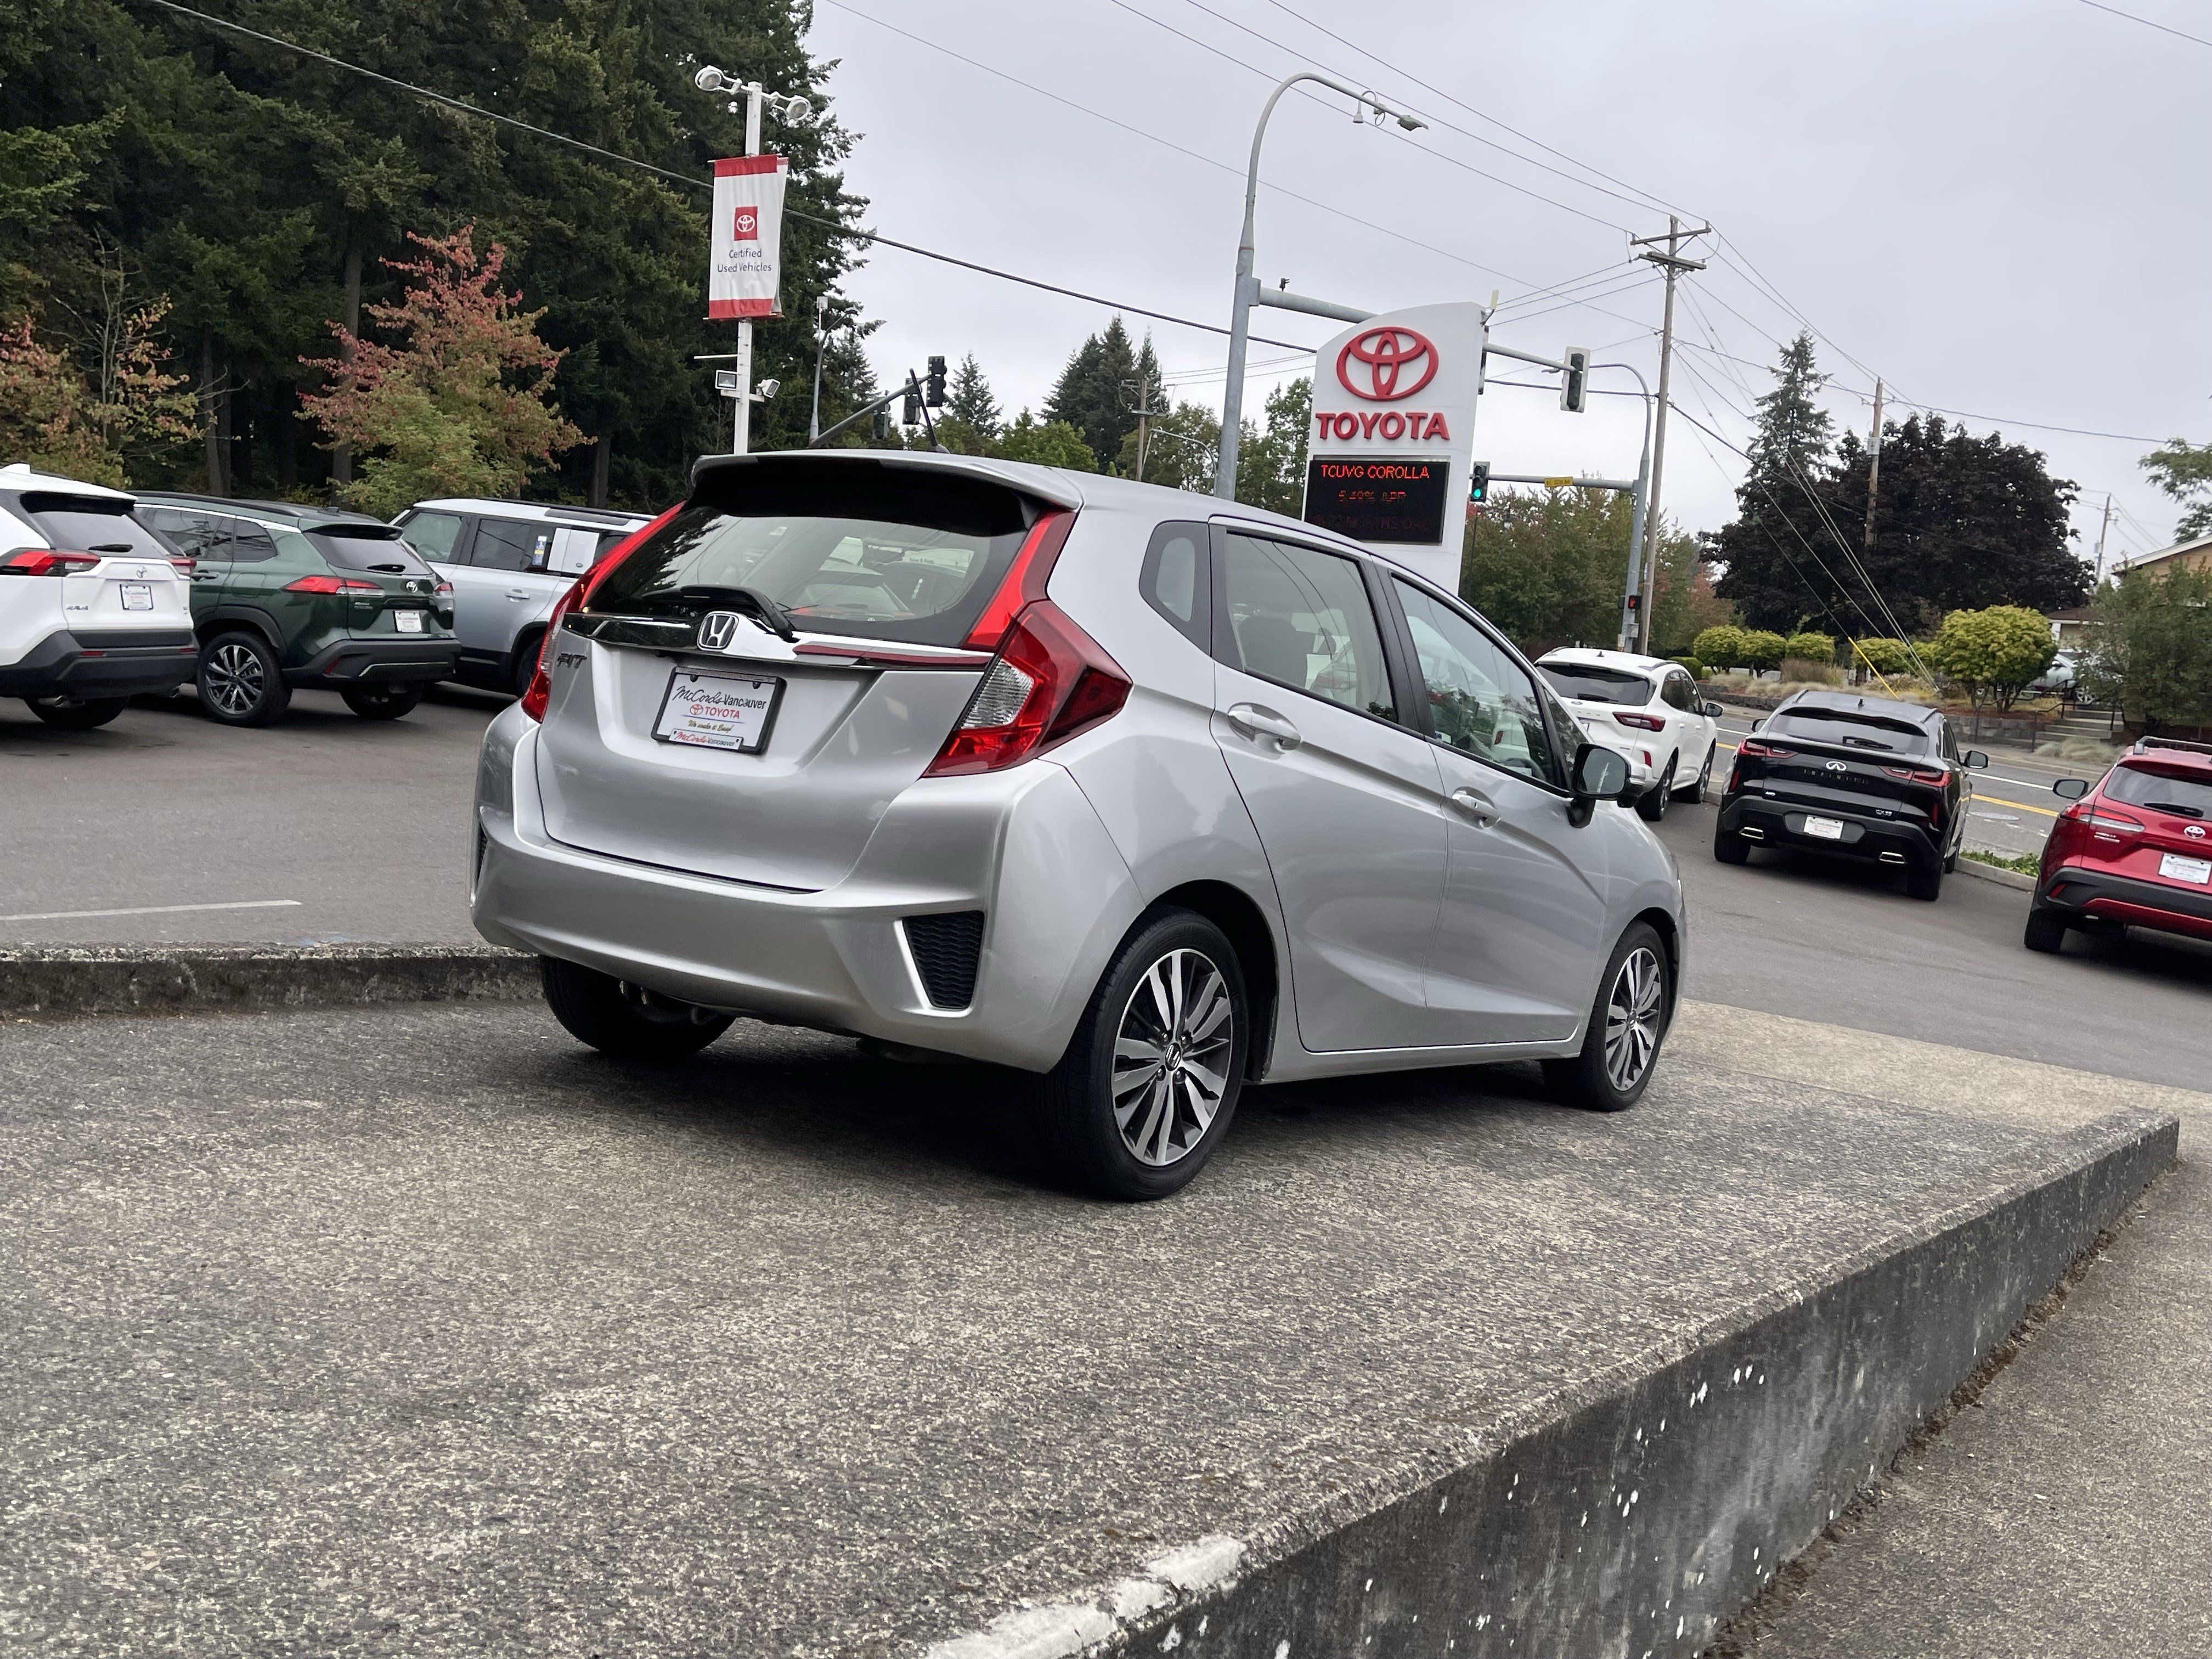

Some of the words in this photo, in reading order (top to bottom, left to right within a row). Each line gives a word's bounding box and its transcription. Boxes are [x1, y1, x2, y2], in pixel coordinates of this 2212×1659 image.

[729, 247, 762, 259] Certified
[717, 262, 737, 273] Used
[739, 262, 772, 272] Vehicles
[1316, 411, 1451, 441] TOYOTA
[1367, 465, 1430, 479] COROLLA
[556, 653, 588, 669] FIT
[705, 706, 740, 719] TOYOTA
